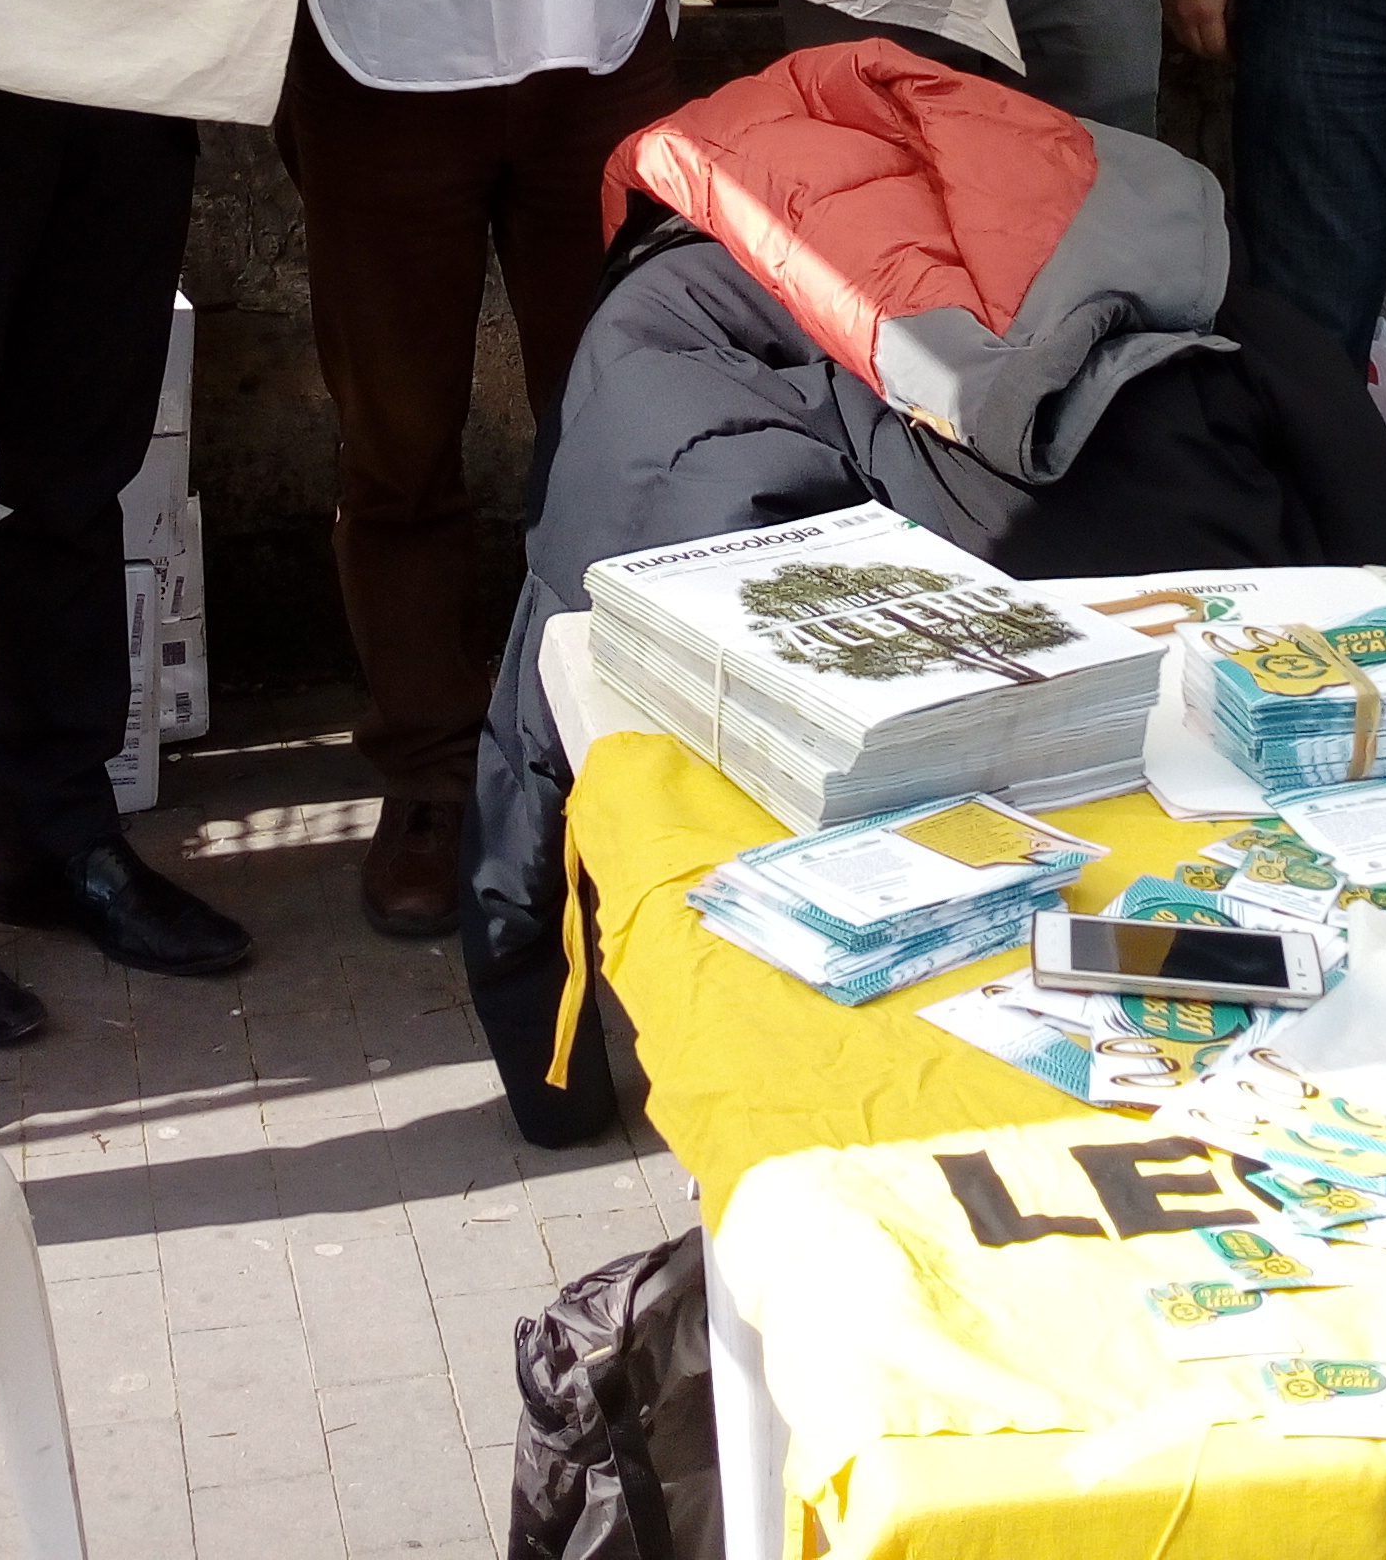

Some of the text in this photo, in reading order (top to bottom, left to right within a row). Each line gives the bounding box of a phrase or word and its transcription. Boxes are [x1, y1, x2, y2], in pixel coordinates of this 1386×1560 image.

[622, 548, 711, 574] nuova
[709, 525, 826, 555] ecologia
[784, 589, 1011, 659] ALBERO
[1335, 628, 1386, 642] SONO
[1205, 1295, 1256, 1308] LEGALE
[1326, 1376, 1381, 1389] LEGALE
